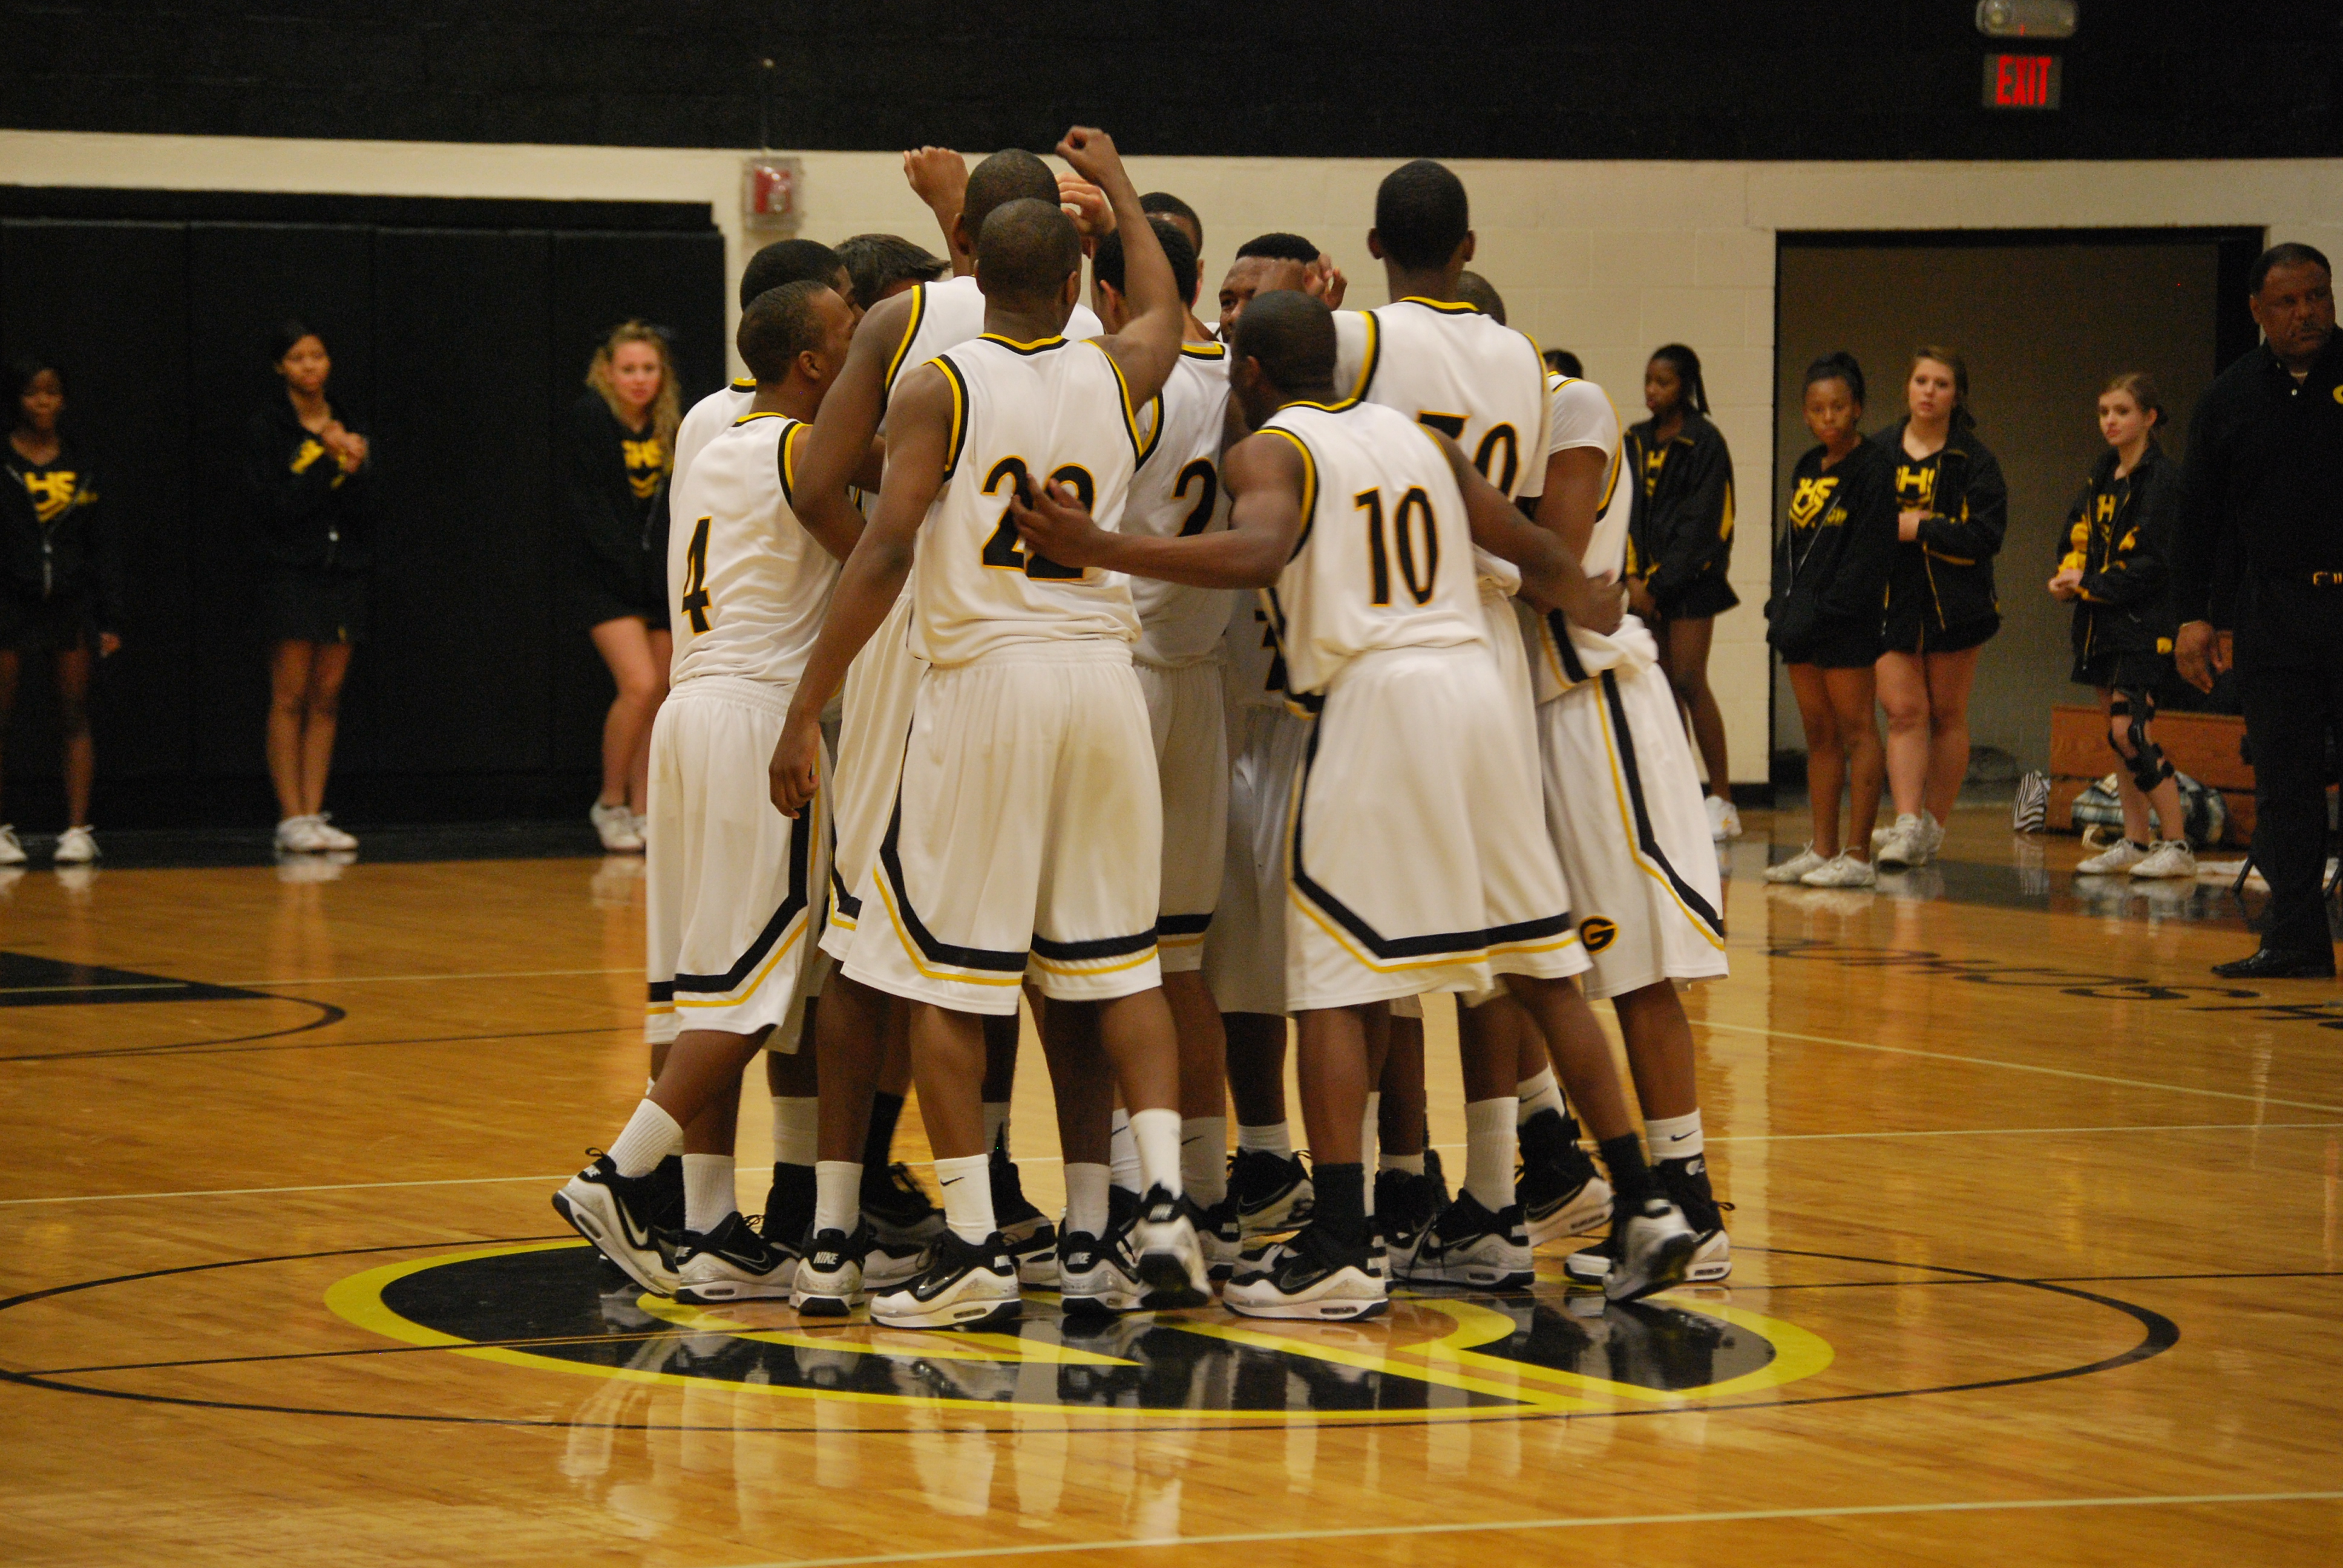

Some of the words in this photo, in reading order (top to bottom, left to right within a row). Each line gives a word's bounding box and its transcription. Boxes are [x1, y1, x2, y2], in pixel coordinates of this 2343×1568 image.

[1997, 54, 2052, 106] EXIT
[681, 515, 713, 635] 4
[1354, 485, 1438, 607] 10
[813, 1251, 839, 1265] NIKE
